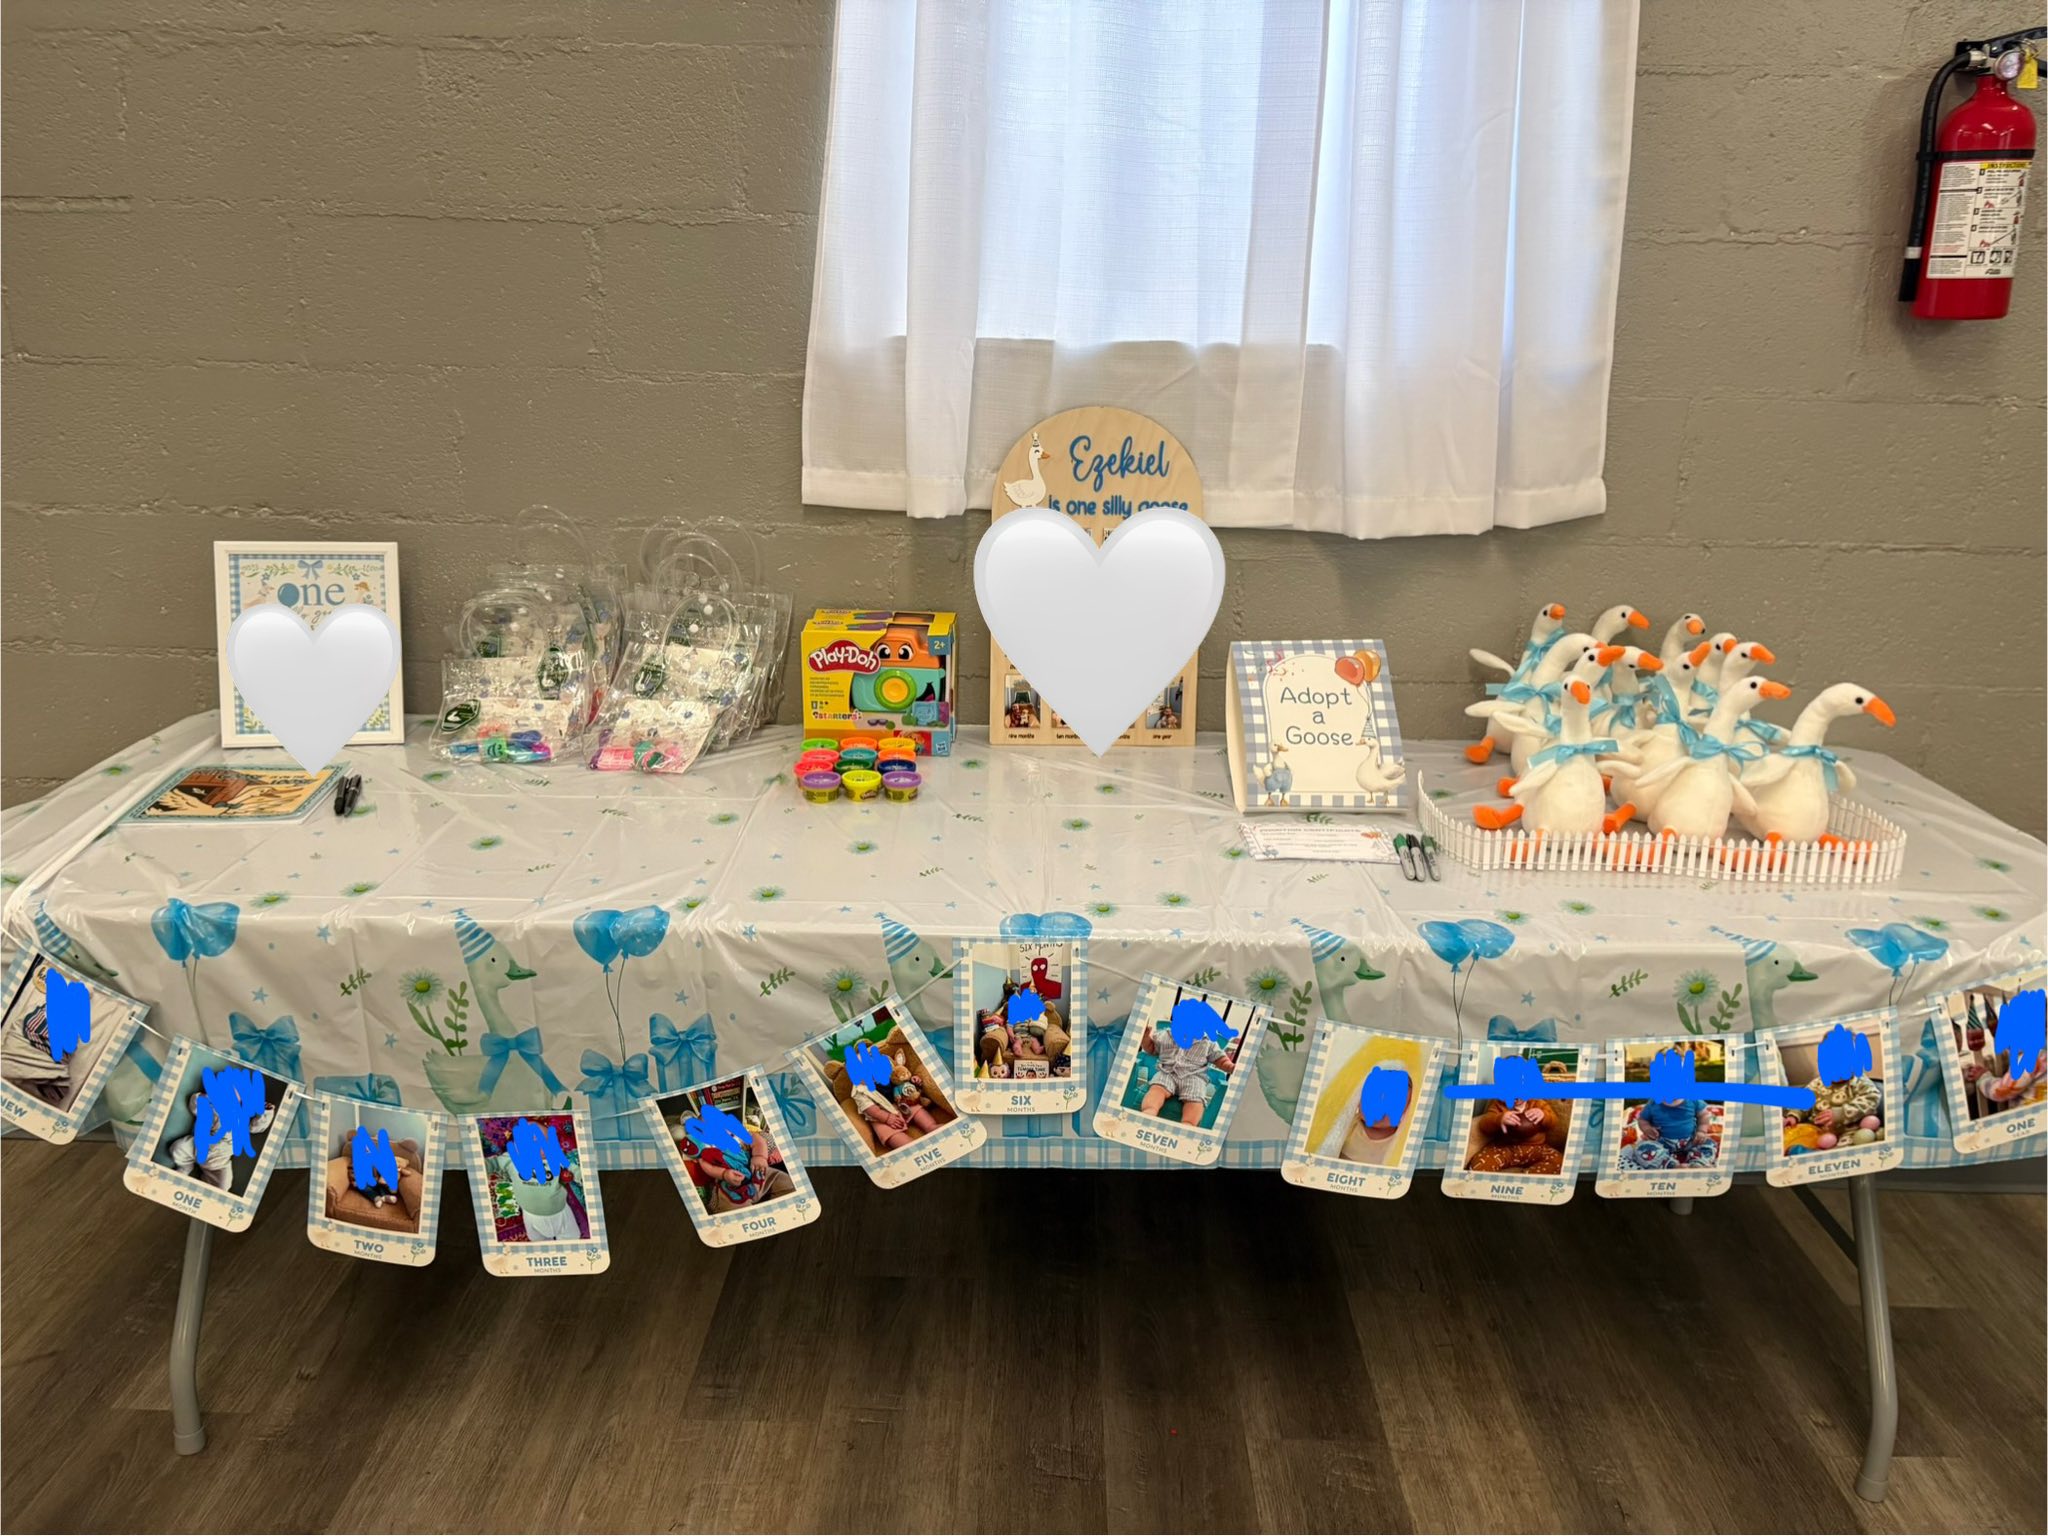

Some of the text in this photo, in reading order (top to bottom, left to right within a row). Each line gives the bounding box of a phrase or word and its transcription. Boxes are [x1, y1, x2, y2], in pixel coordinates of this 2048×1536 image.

[1069, 435, 1170, 492] Ezekiel
[1048, 495, 1060, 512] is
[1066, 500, 1097, 515] one
[1102, 495, 1132, 520] silly
[933, 640, 946, 650] 2+
[809, 646, 878, 670] Play-Doh
[1280, 687, 1353, 709] Adopt
[1312, 710, 1326, 725] a
[1285, 726, 1354, 746] Goose
[1011, 1095, 1032, 1106] SIX
[2006, 1117, 2036, 1134] ONE
[1135, 1129, 1178, 1150] SEVEN
[1140, 1141, 1167, 1154] MONTHS
[914, 1147, 942, 1167] FIVE
[920, 1157, 946, 1171] MONTHS
[1808, 1158, 1861, 1175] ELEVEN
[1326, 1172, 1366, 1187] EIGHT
[1650, 1182, 1677, 1191] TEN
[1330, 1183, 1359, 1193] MONTHS
[1490, 1184, 1524, 1196] NINE
[173, 1190, 202, 1209] ONE
[741, 1216, 777, 1233] FOUR
[353, 1239, 385, 1253] TWO
[525, 1256, 568, 1268] THREE
